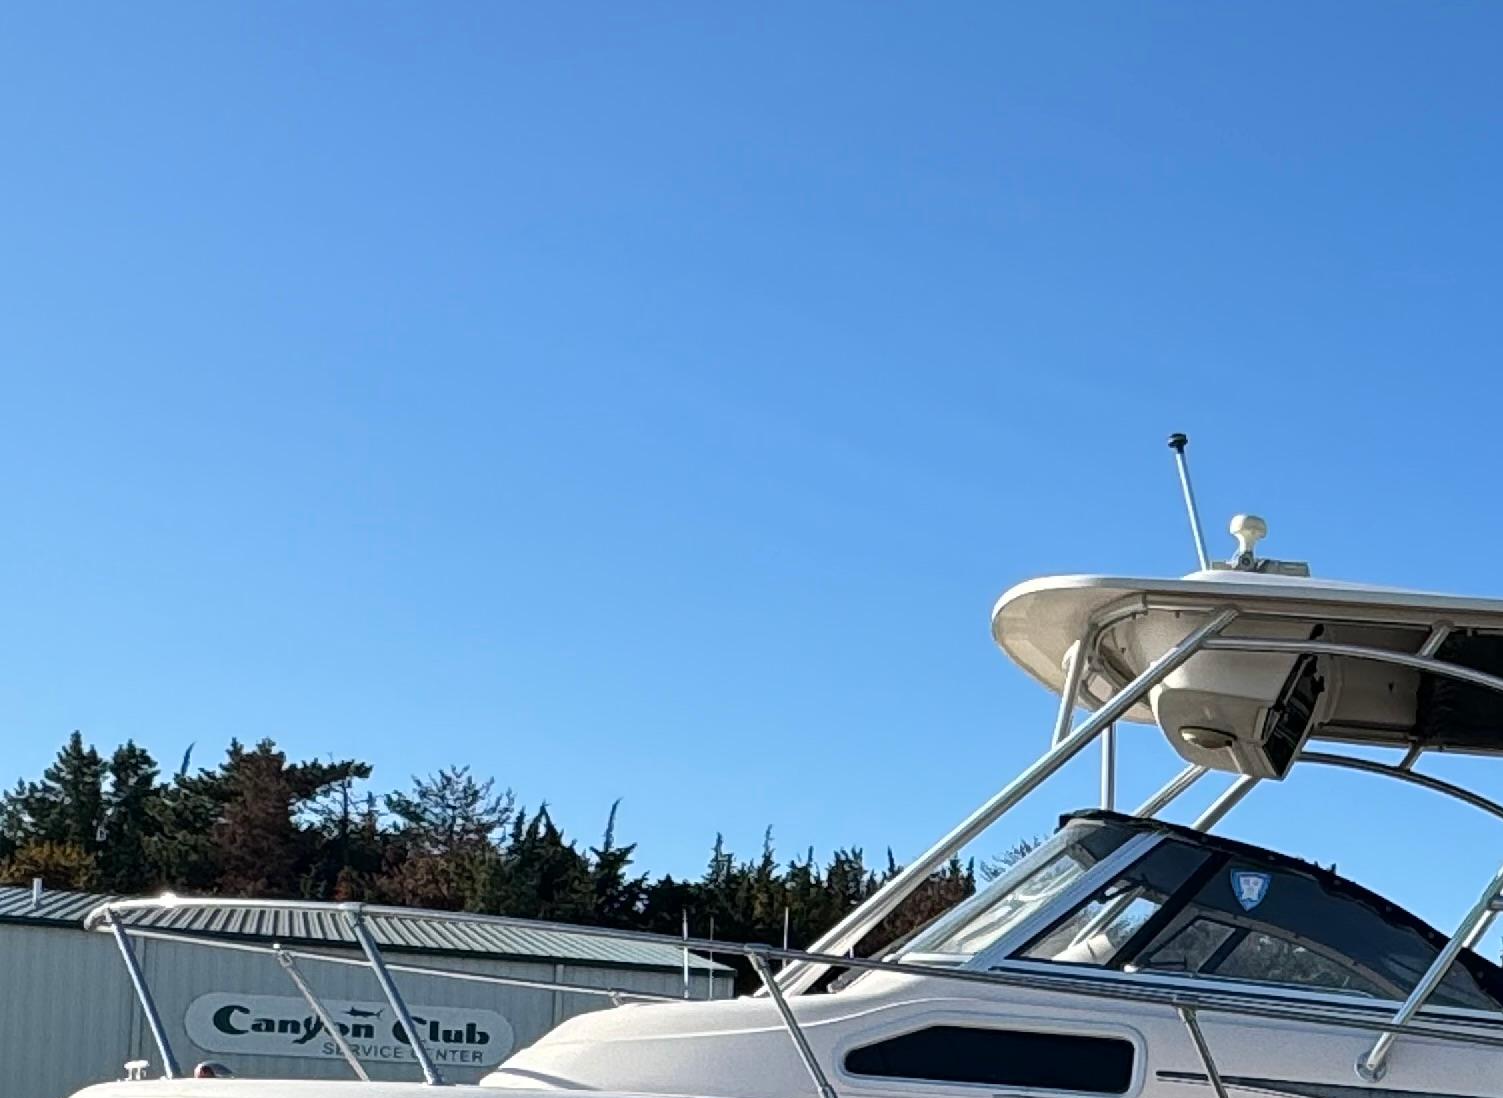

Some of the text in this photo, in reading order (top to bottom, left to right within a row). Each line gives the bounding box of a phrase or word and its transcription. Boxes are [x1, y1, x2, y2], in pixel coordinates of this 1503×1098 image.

[212, 1004, 491, 1045] Canyon Club
[410, 1044, 484, 1064] CNTER
